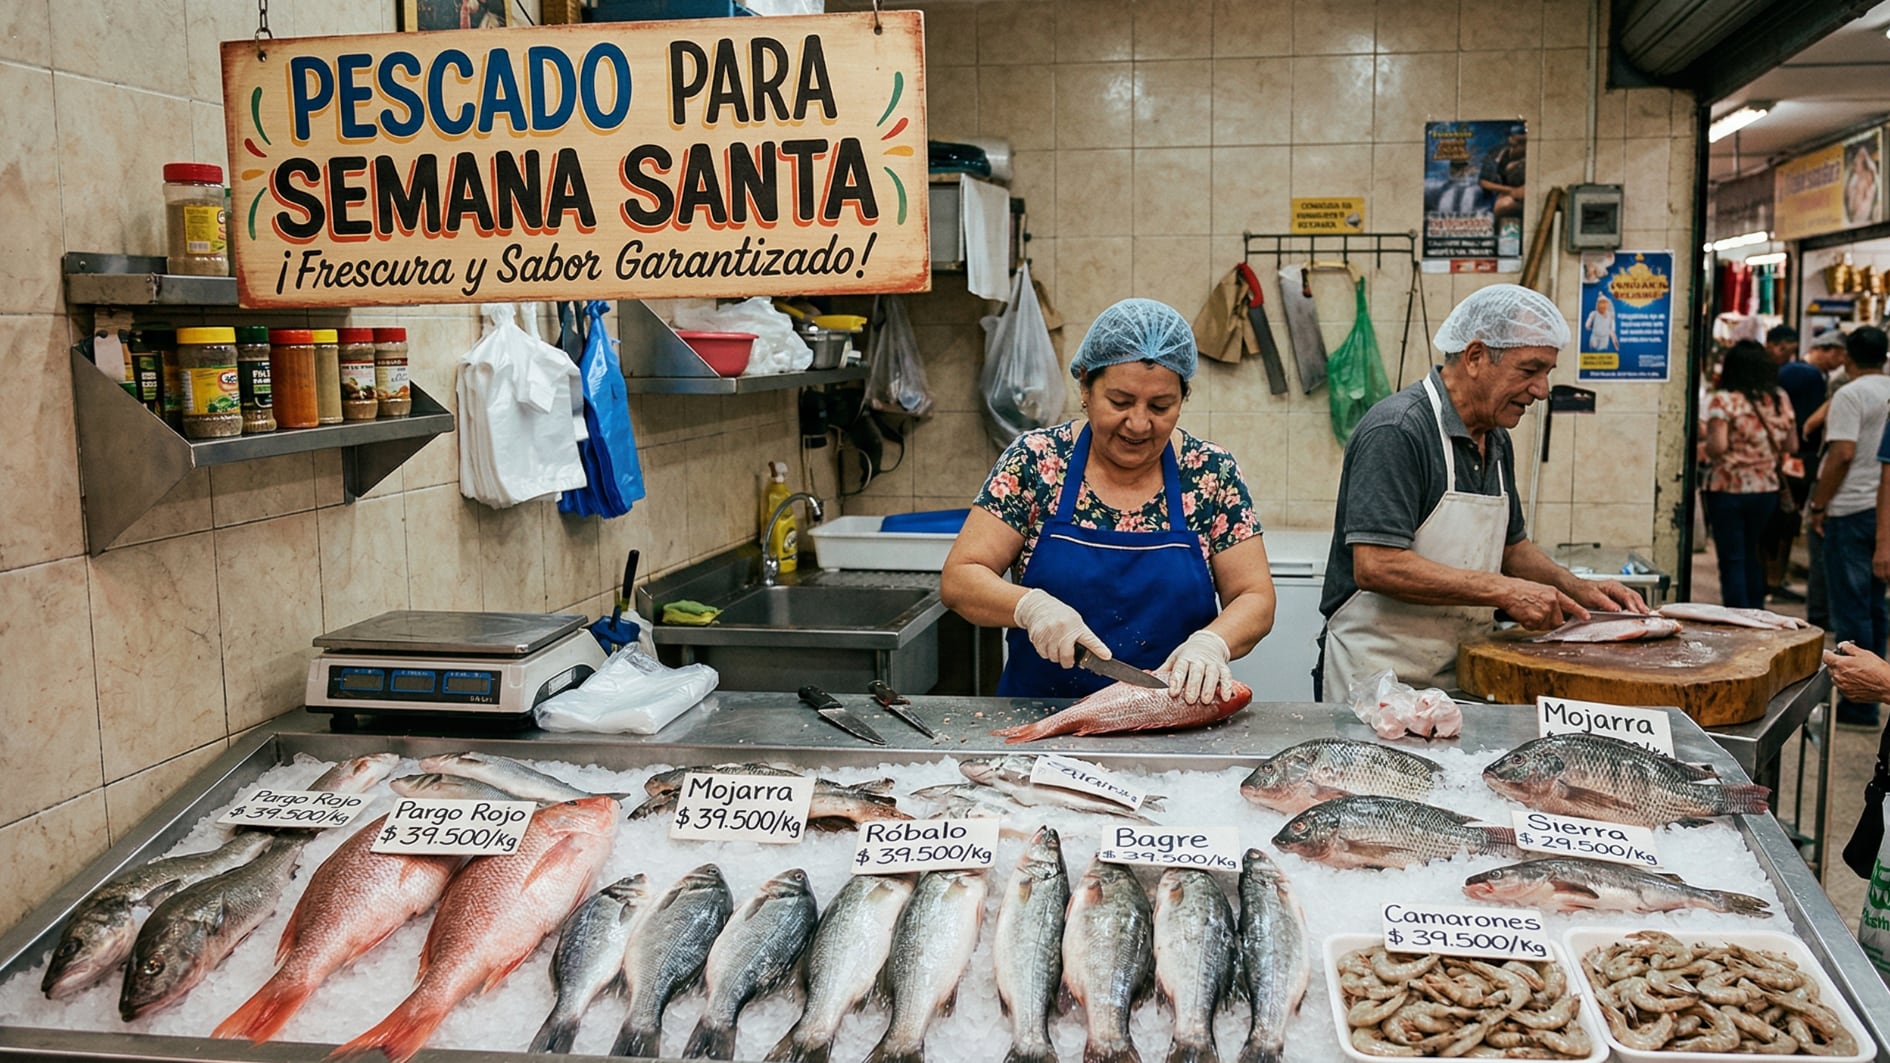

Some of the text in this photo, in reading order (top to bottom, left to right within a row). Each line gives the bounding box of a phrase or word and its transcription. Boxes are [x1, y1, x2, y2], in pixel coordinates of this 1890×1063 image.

[287, 34, 838, 145] PESCADO PARA
[270, 138, 879, 243] SEMANA SANTA
[276, 231, 878, 297] ¡Frescura y Sabor Garantizado!
[1544, 701, 1655, 736] Mojarra
[250, 790, 362, 809] Pargo Rojo
[688, 776, 793, 806] Mojarra
[395, 800, 526, 827] Pargo Rojo
[675, 806, 801, 839] $ 39.500/Kg
[1527, 813, 1629, 842] Sierra
[380, 825, 518, 852] $ 39.500/Kg
[866, 821, 967, 843] Róbalo
[1115, 827, 1209, 853] Bagre
[855, 848, 870, 866] $
[1518, 831, 1658, 866] $ 29.500/Kg
[1384, 904, 1541, 931] Camarones
[1388, 928, 1547, 958] $ 39.500/Kg
